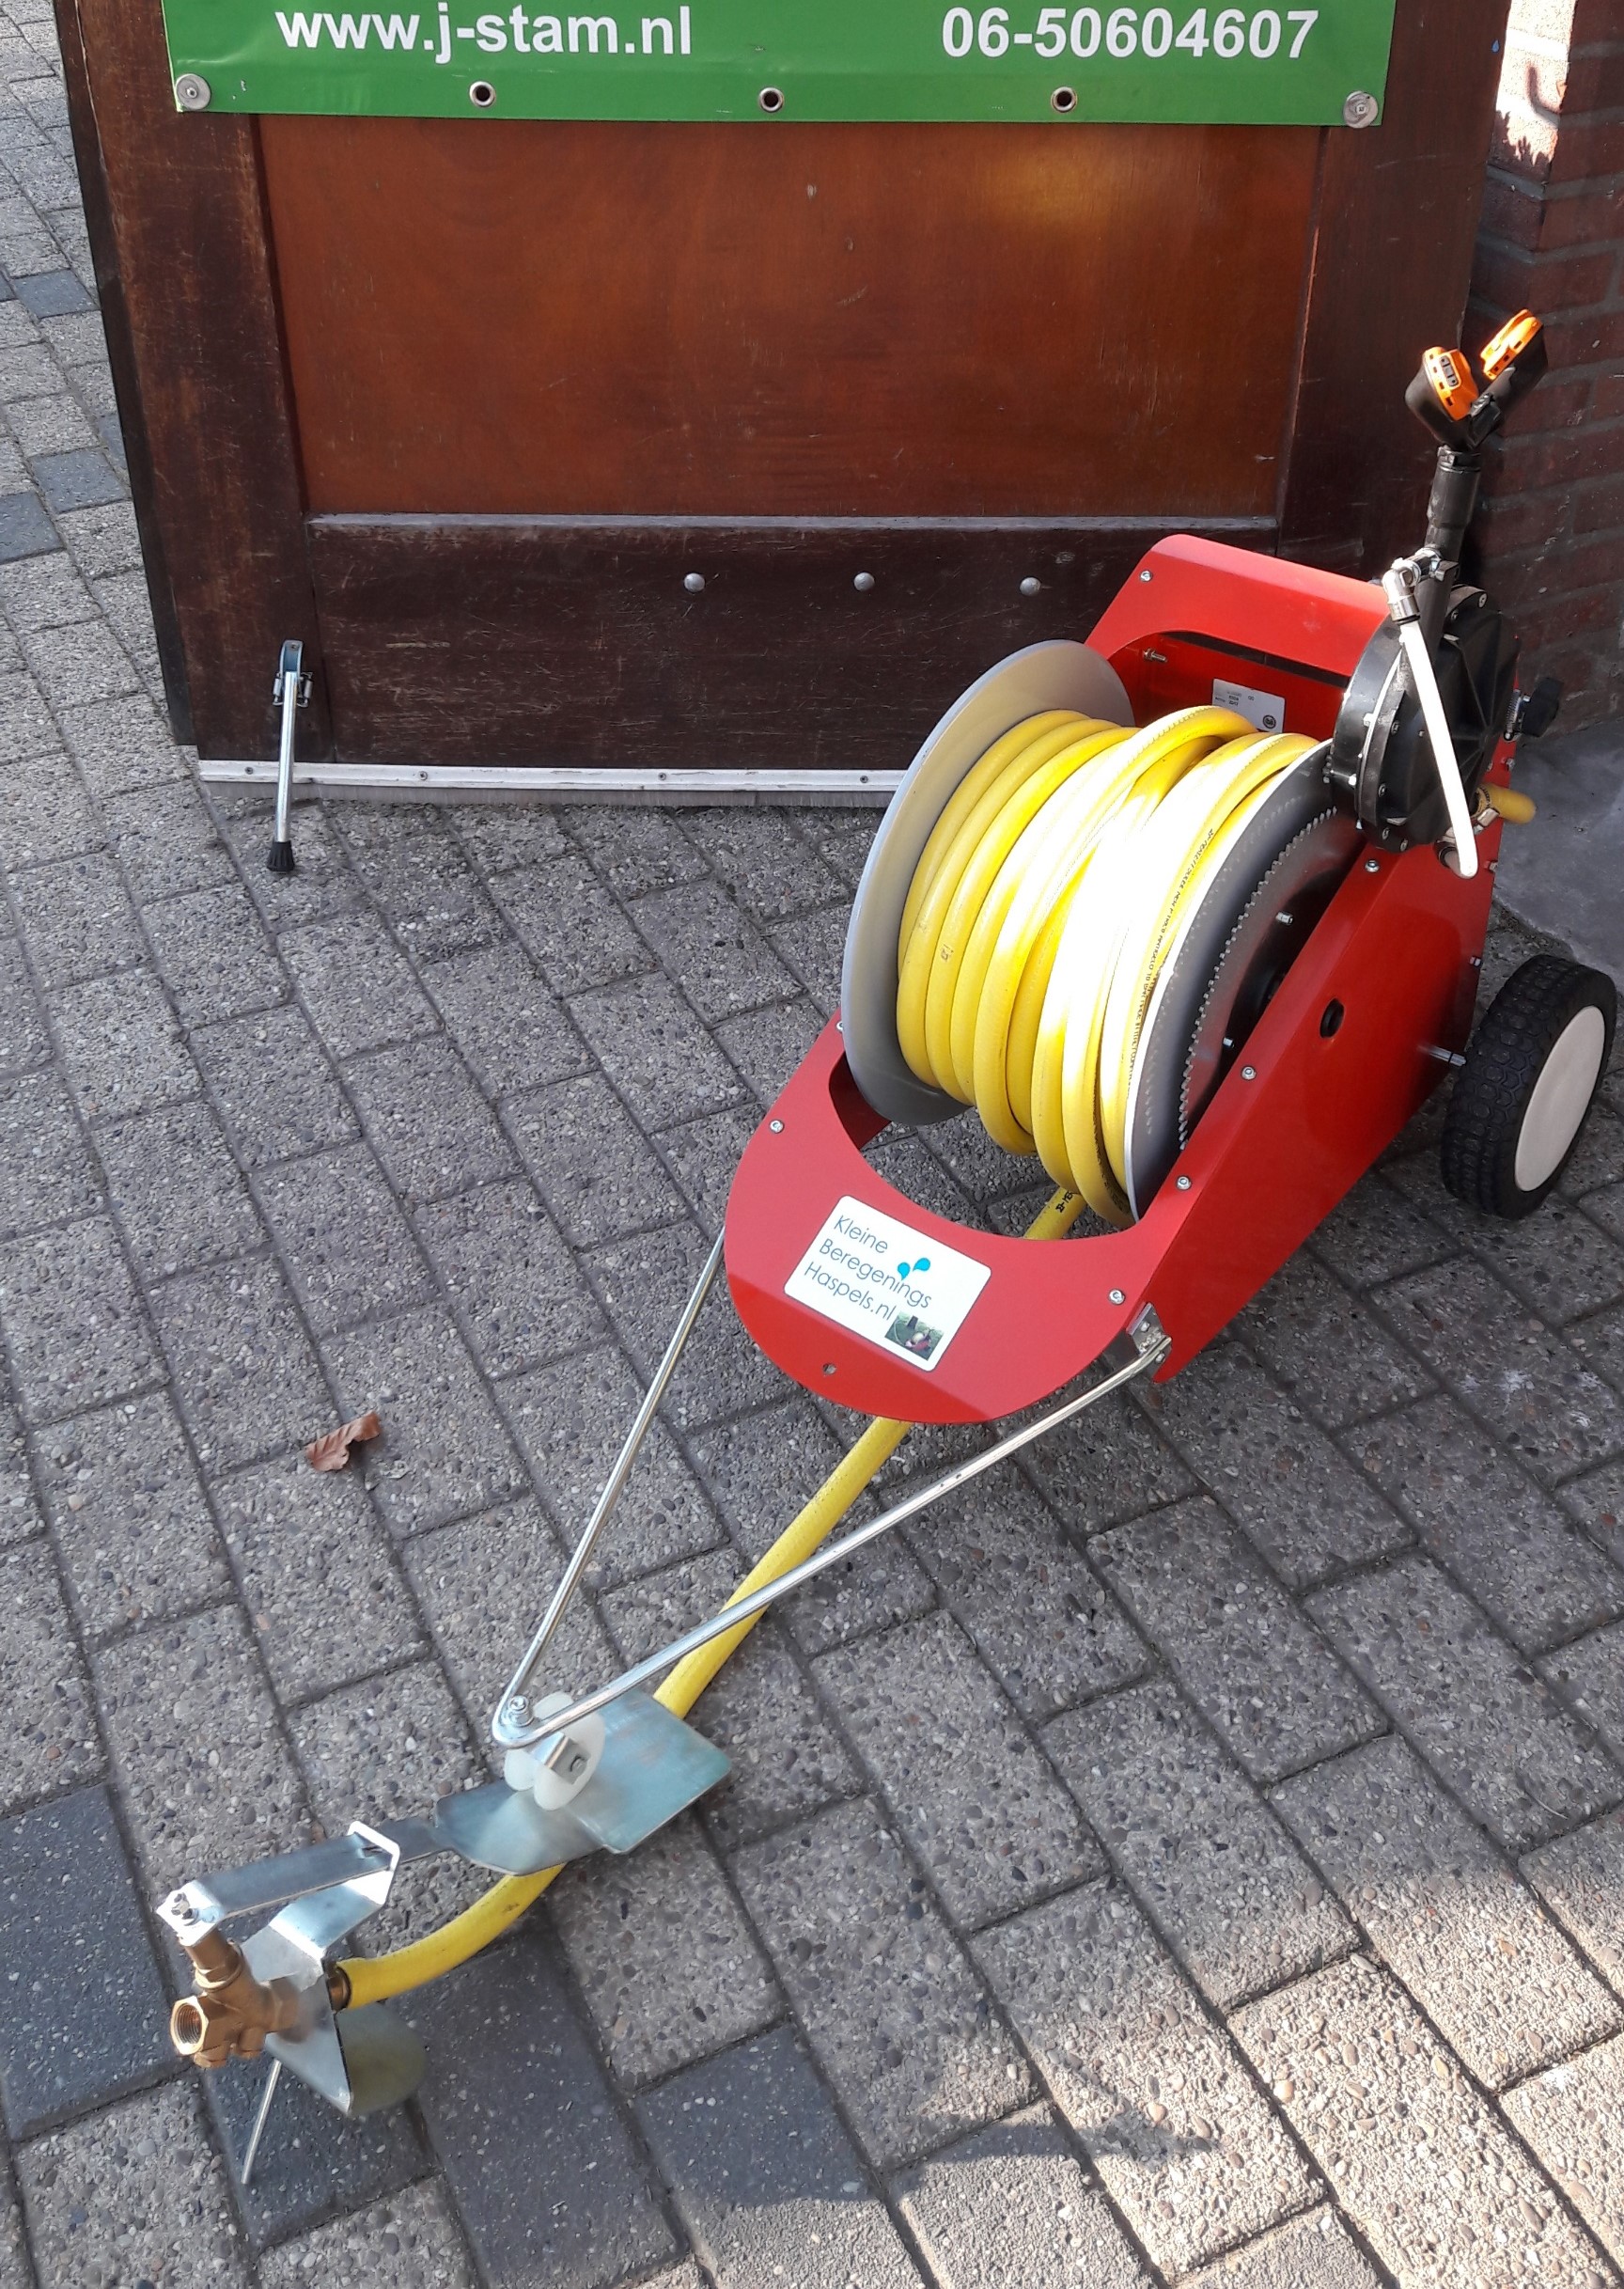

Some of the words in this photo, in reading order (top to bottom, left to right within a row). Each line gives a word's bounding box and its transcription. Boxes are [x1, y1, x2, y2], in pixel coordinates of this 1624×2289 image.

[275, 3, 691, 64] www.j-stam.nl
[942, 7, 1320, 58] 06-50604607
[834, 1215, 888, 1253] Kleine
[804, 1262, 897, 1321] Haspels.nl
[820, 1238, 932, 1309] Beregenings
